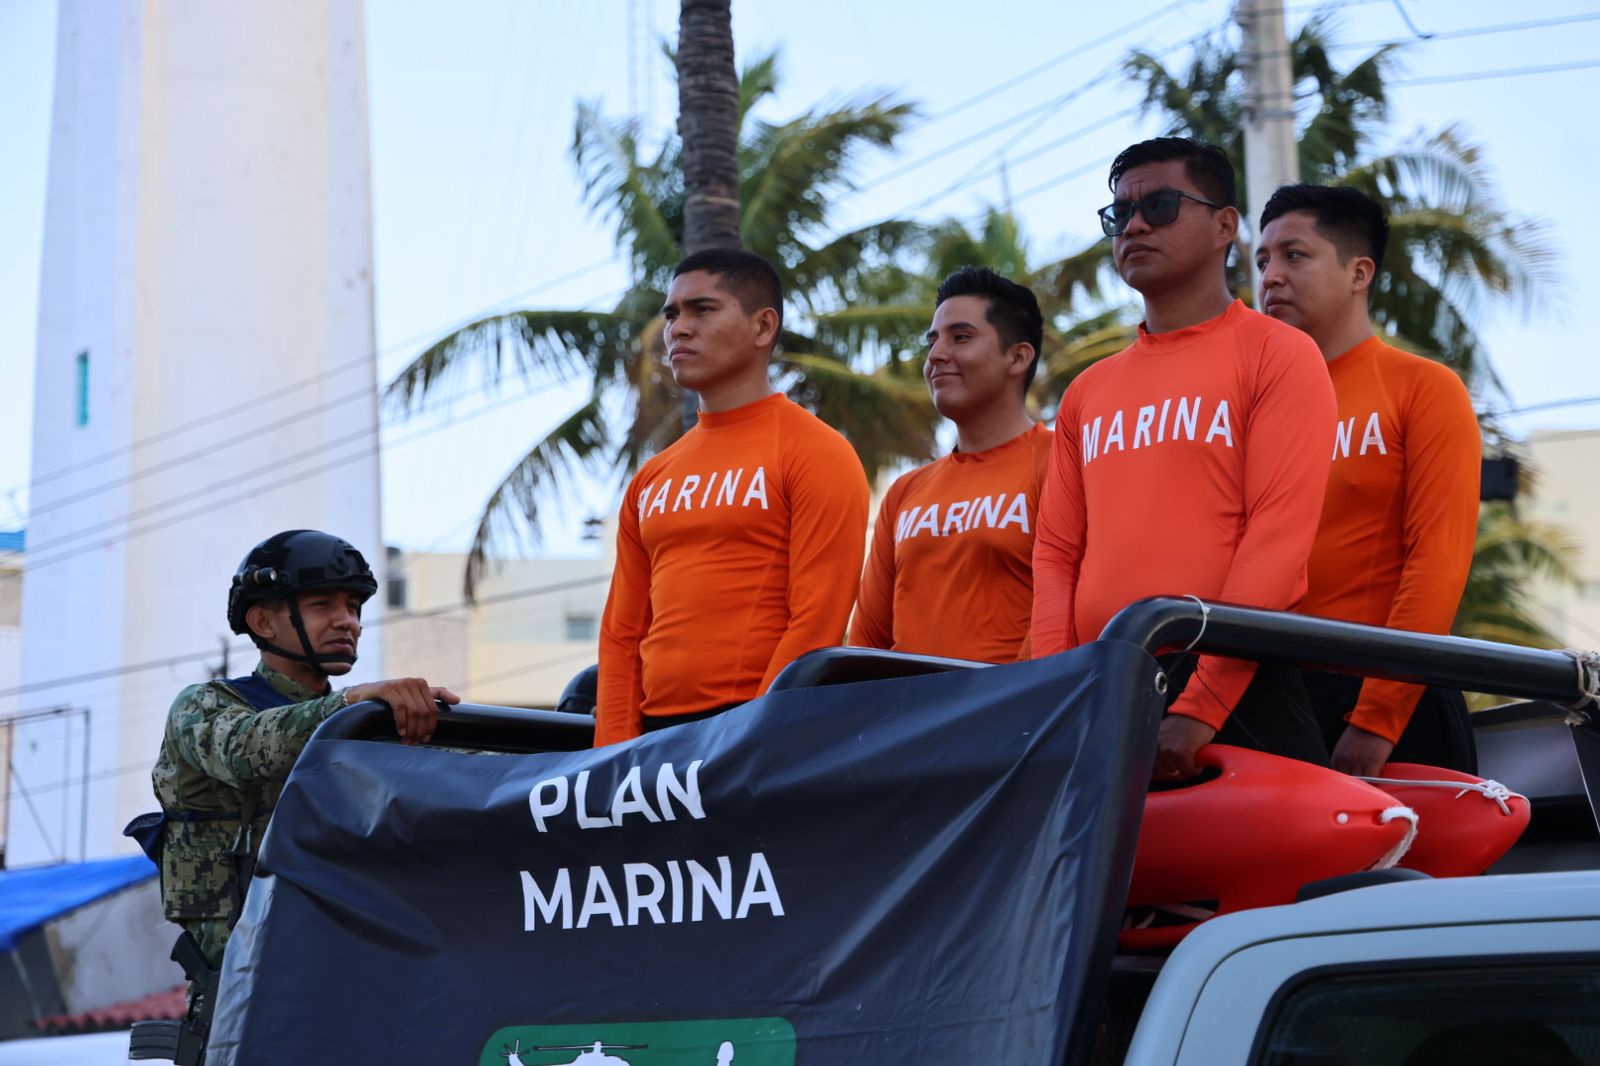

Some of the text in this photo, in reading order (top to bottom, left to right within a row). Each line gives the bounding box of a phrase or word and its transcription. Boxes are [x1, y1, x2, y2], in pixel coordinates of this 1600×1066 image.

[1083, 396, 1233, 467] MARINA
[895, 493, 1030, 543] MARINA
[529, 760, 706, 833] PLAN
[520, 852, 785, 931] MARINA
